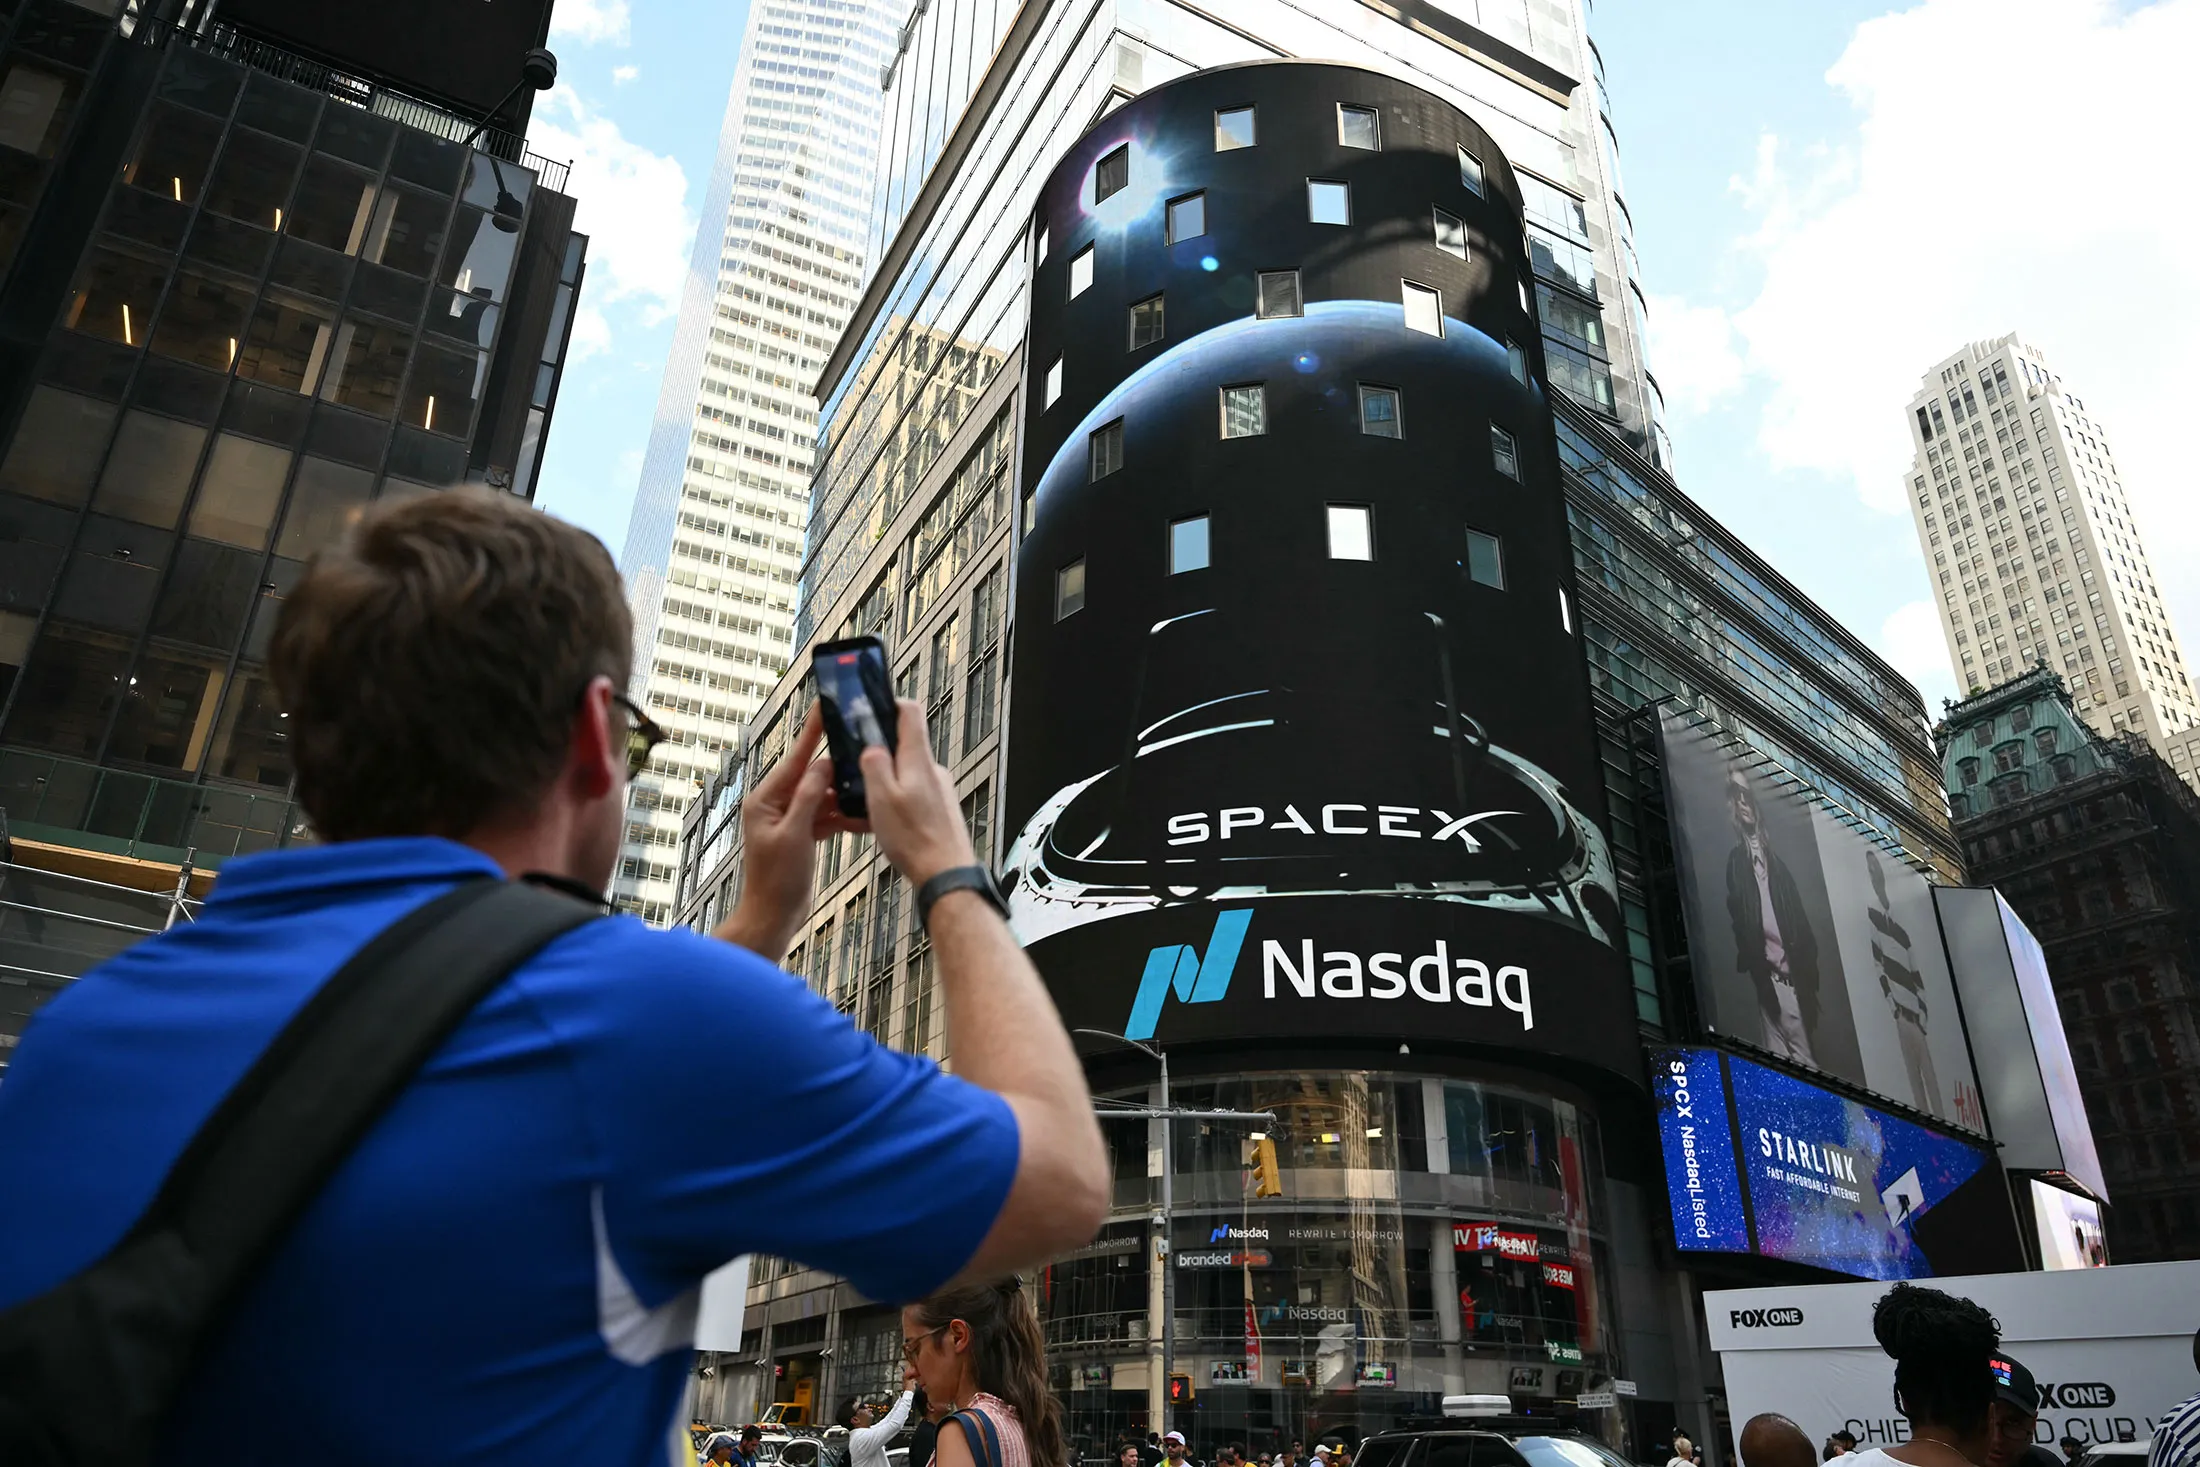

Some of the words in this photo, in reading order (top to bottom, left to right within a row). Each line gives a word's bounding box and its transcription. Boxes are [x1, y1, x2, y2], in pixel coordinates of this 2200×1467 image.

[1167, 803, 1525, 847] SPACEX
[1263, 939, 1534, 1031] Nasdaq
[1670, 1061, 1693, 1119] SPCX
[1759, 1128, 1858, 1184] STARLINK
[1766, 1166, 1784, 1181] FAST
[1786, 1171, 1830, 1195] AFFORDABLE
[1830, 1185, 1861, 1204] INTERNET
[1229, 1227, 1269, 1241] Nasdaq
[1289, 1229, 1337, 1239] REWRITE
[1343, 1229, 1402, 1240] TOMORROW
[1289, 1305, 1347, 1323] Nasdaq
[1730, 1309, 1768, 1328] FOX
[1770, 1310, 1800, 1324] ONE
[2066, 1386, 2110, 1407] ONE
